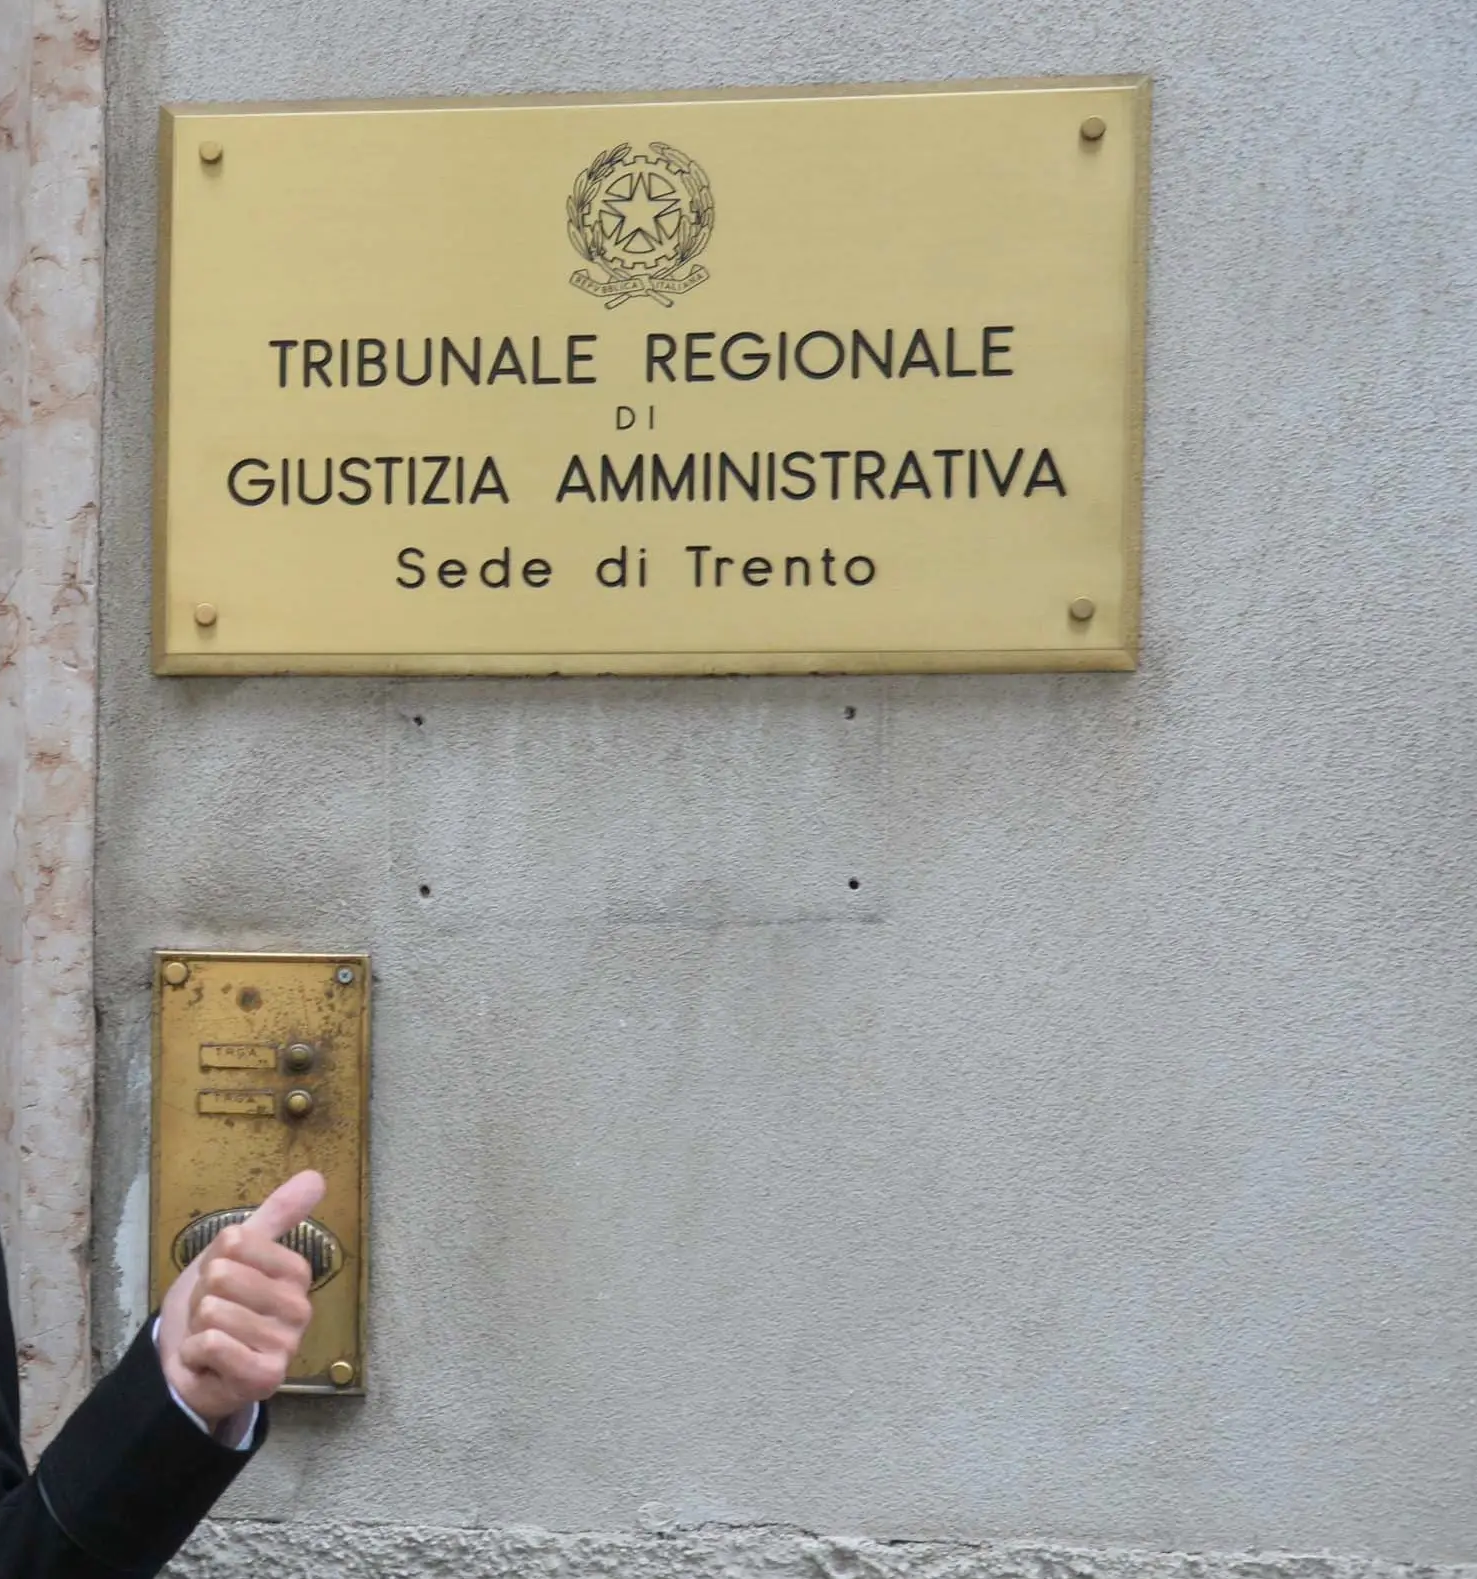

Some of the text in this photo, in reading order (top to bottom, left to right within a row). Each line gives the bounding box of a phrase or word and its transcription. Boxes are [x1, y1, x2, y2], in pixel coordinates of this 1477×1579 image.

[654, 271, 705, 291] ITALIANA
[268, 325, 1015, 389] TRIBUNALE REGIONALE
[615, 405, 654, 431] DI
[226, 447, 1068, 507] GIUSTIZIA AMMINISTRATIVA
[395, 545, 877, 590] Sede di Trento
